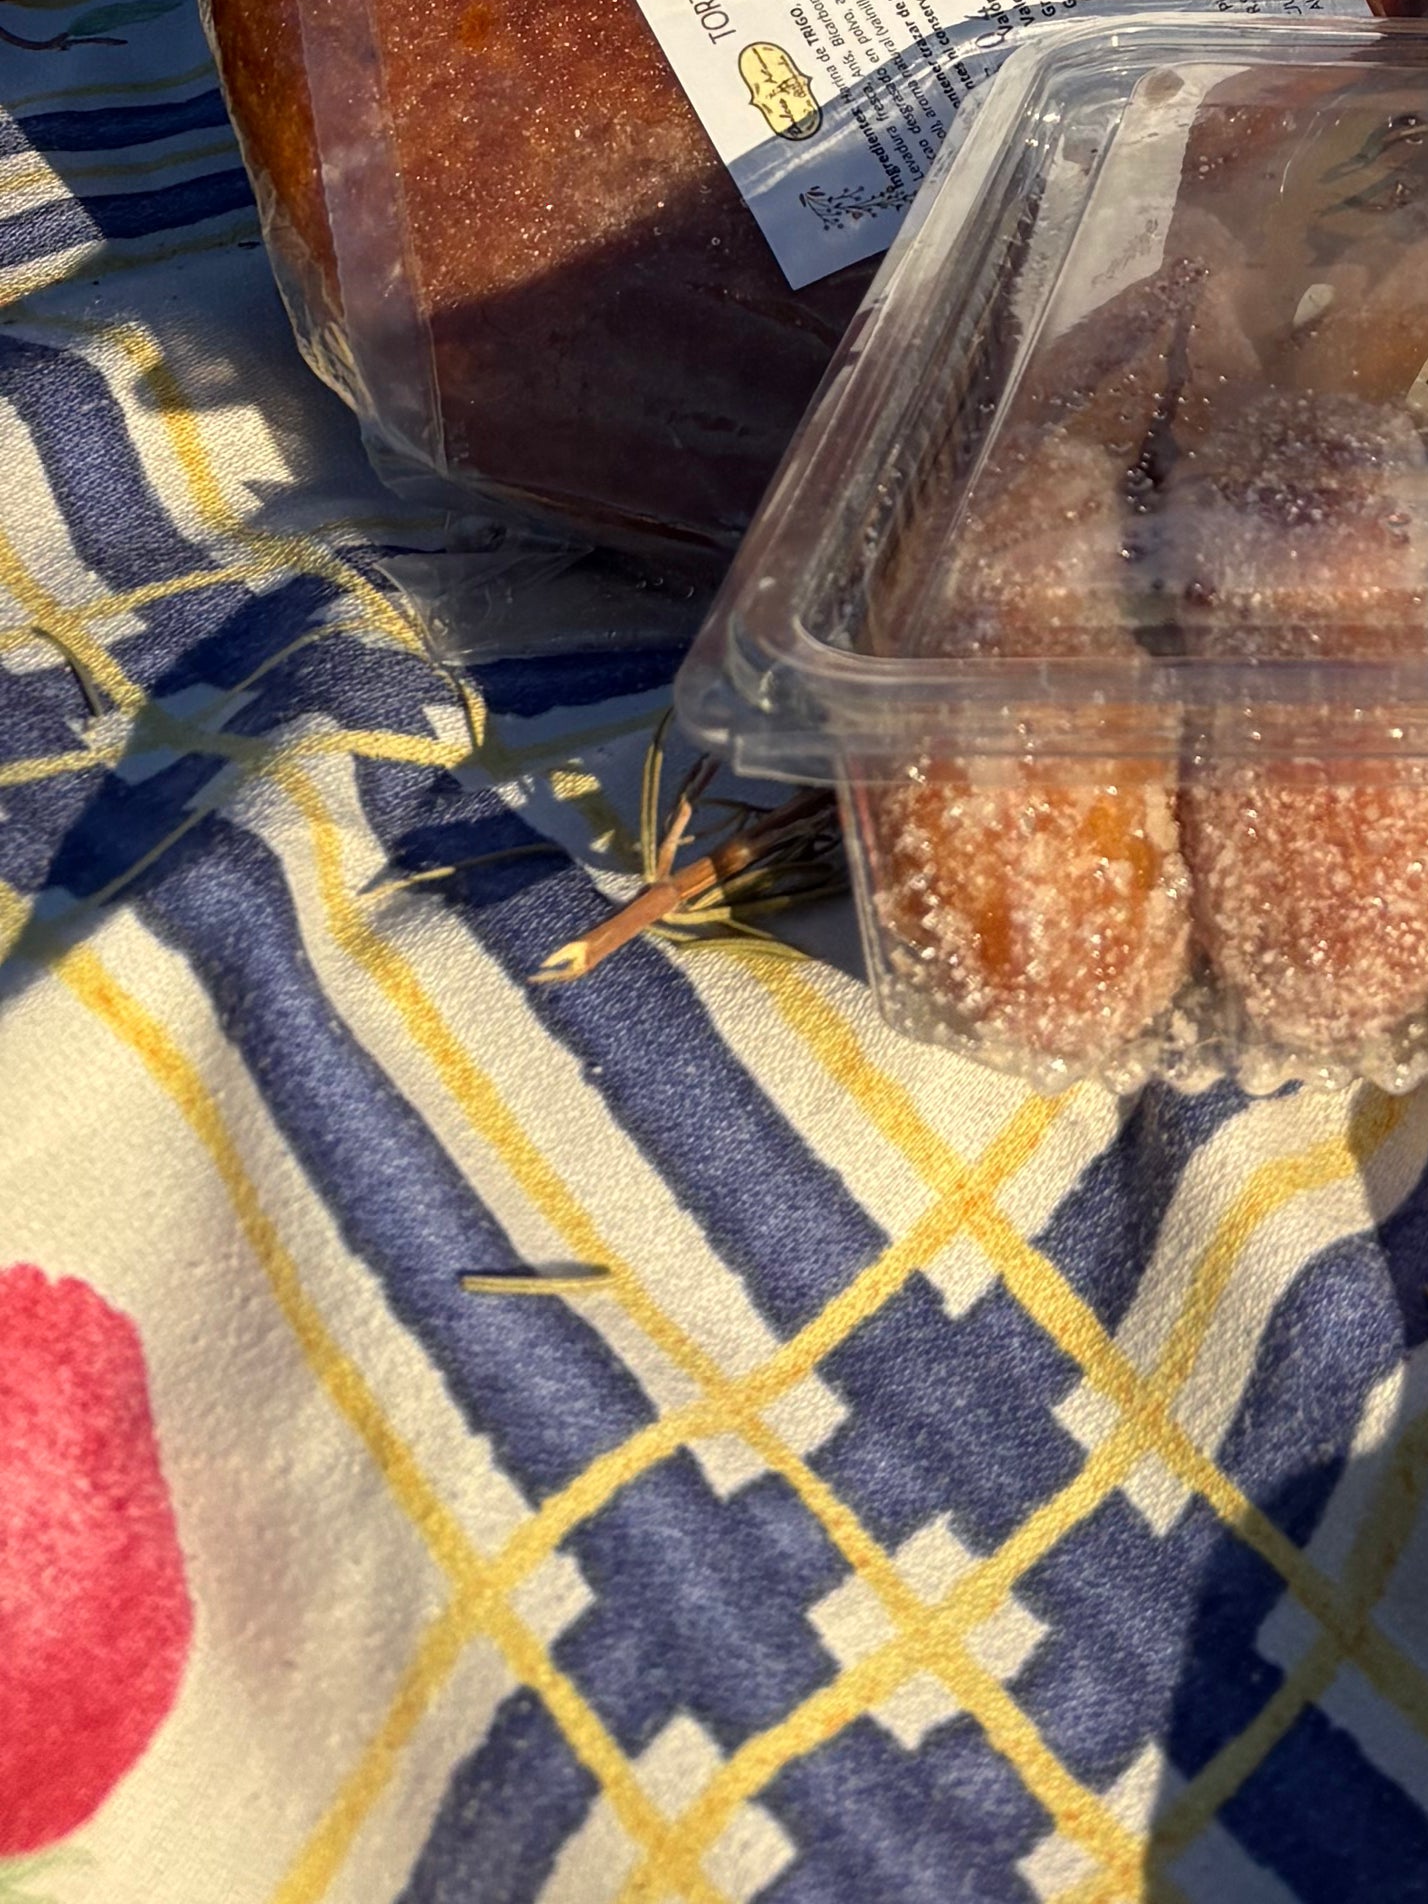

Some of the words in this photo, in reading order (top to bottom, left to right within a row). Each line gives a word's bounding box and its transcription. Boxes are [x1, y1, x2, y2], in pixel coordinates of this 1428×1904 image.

[790, 3, 818, 46] TRIGO,
[844, 8, 871, 43] polvo,
[896, 1, 909, 17] de
[816, 47, 829, 61] de
[865, 48, 879, 62] en
[904, 19, 934, 57] trazar
[821, 64, 855, 104] Harina
[886, 125, 924, 181] Levadura
